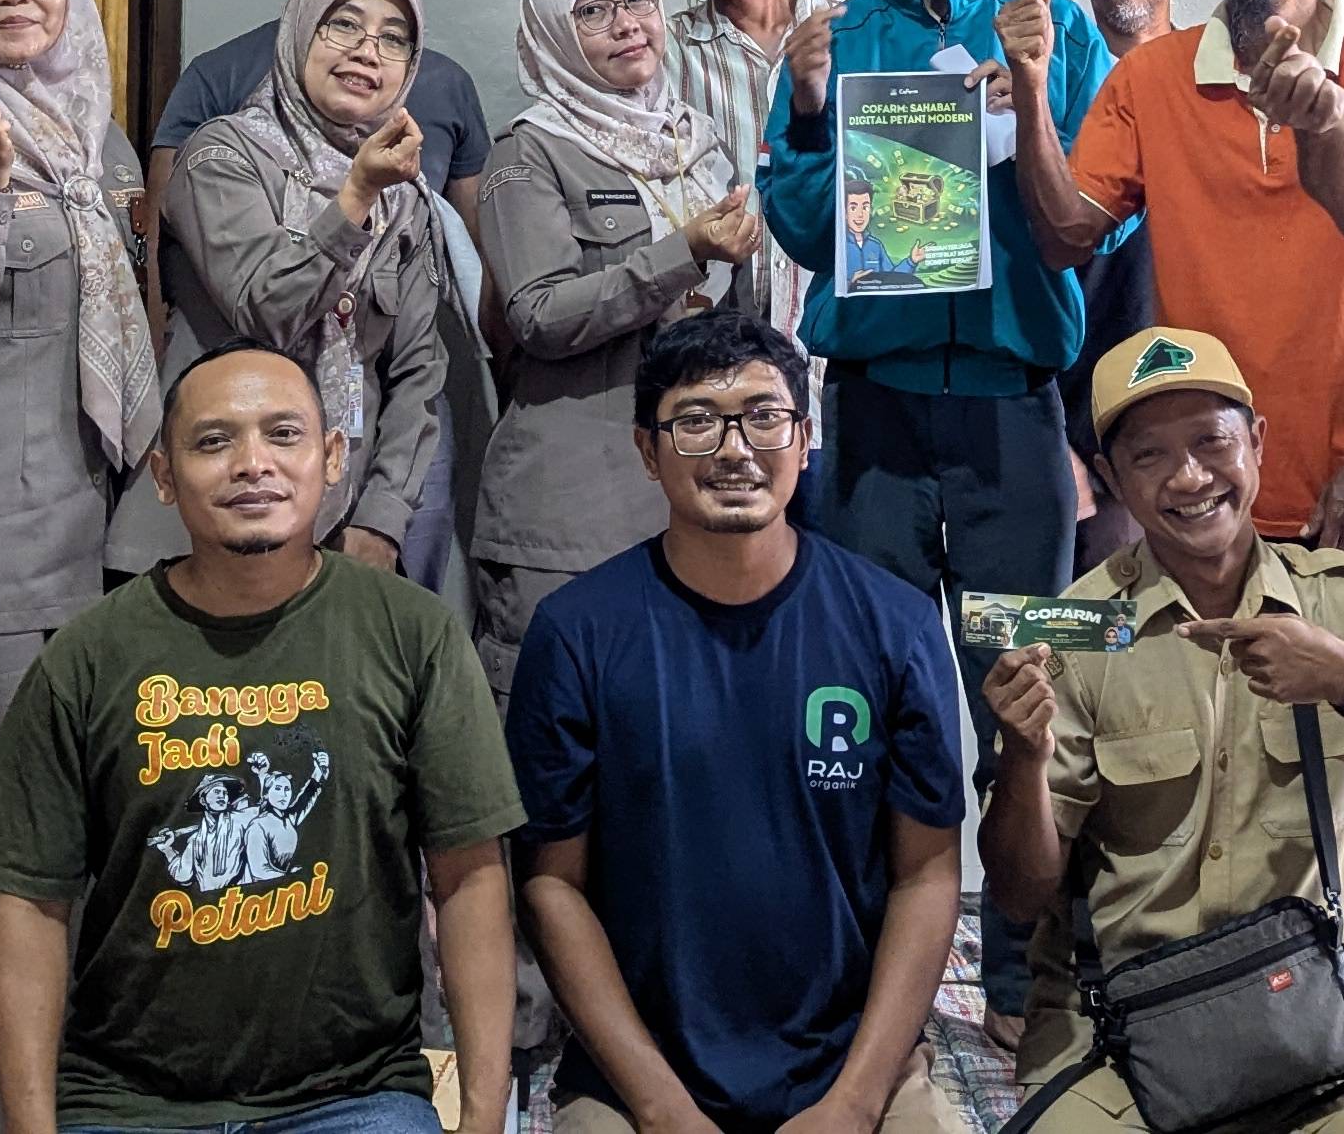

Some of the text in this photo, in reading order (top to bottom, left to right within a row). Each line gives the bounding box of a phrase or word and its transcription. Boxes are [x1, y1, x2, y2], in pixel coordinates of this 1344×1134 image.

[862, 102, 957, 114] COFARM: SAHABAT
[849, 113, 973, 126] DIGITAL PETANI MODERN
[1024, 607, 1102, 625] COFARM
[136, 674, 329, 727] Bangga
[138, 723, 240, 785] Jadi
[807, 759, 863, 780] RAJ
[809, 778, 858, 791] organik
[150, 862, 333, 949] Petani
